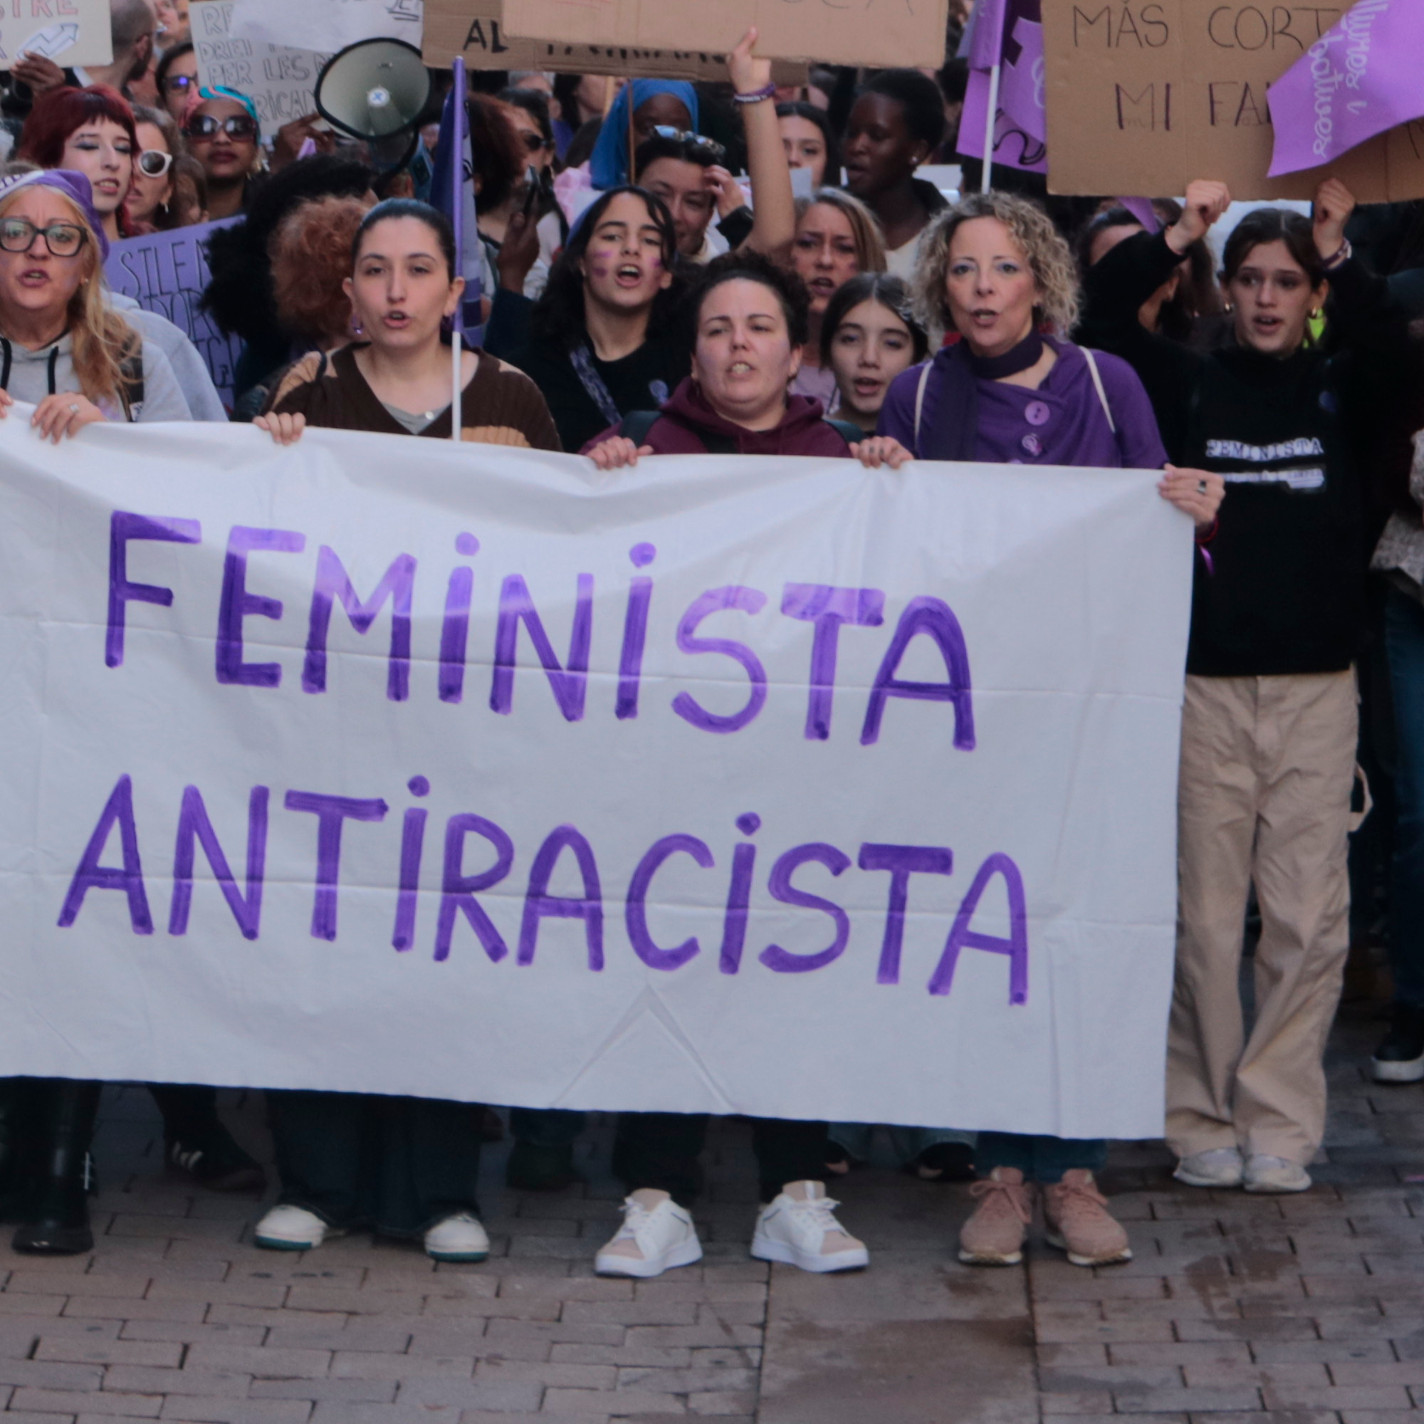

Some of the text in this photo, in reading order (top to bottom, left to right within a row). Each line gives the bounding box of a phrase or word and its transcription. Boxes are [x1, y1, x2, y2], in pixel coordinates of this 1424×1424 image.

[462, 19, 508, 54] AL
[1206, 5, 1342, 52] CORT
[1114, 82, 1172, 133] MI
[1205, 437, 1324, 462] FEMINISTA
